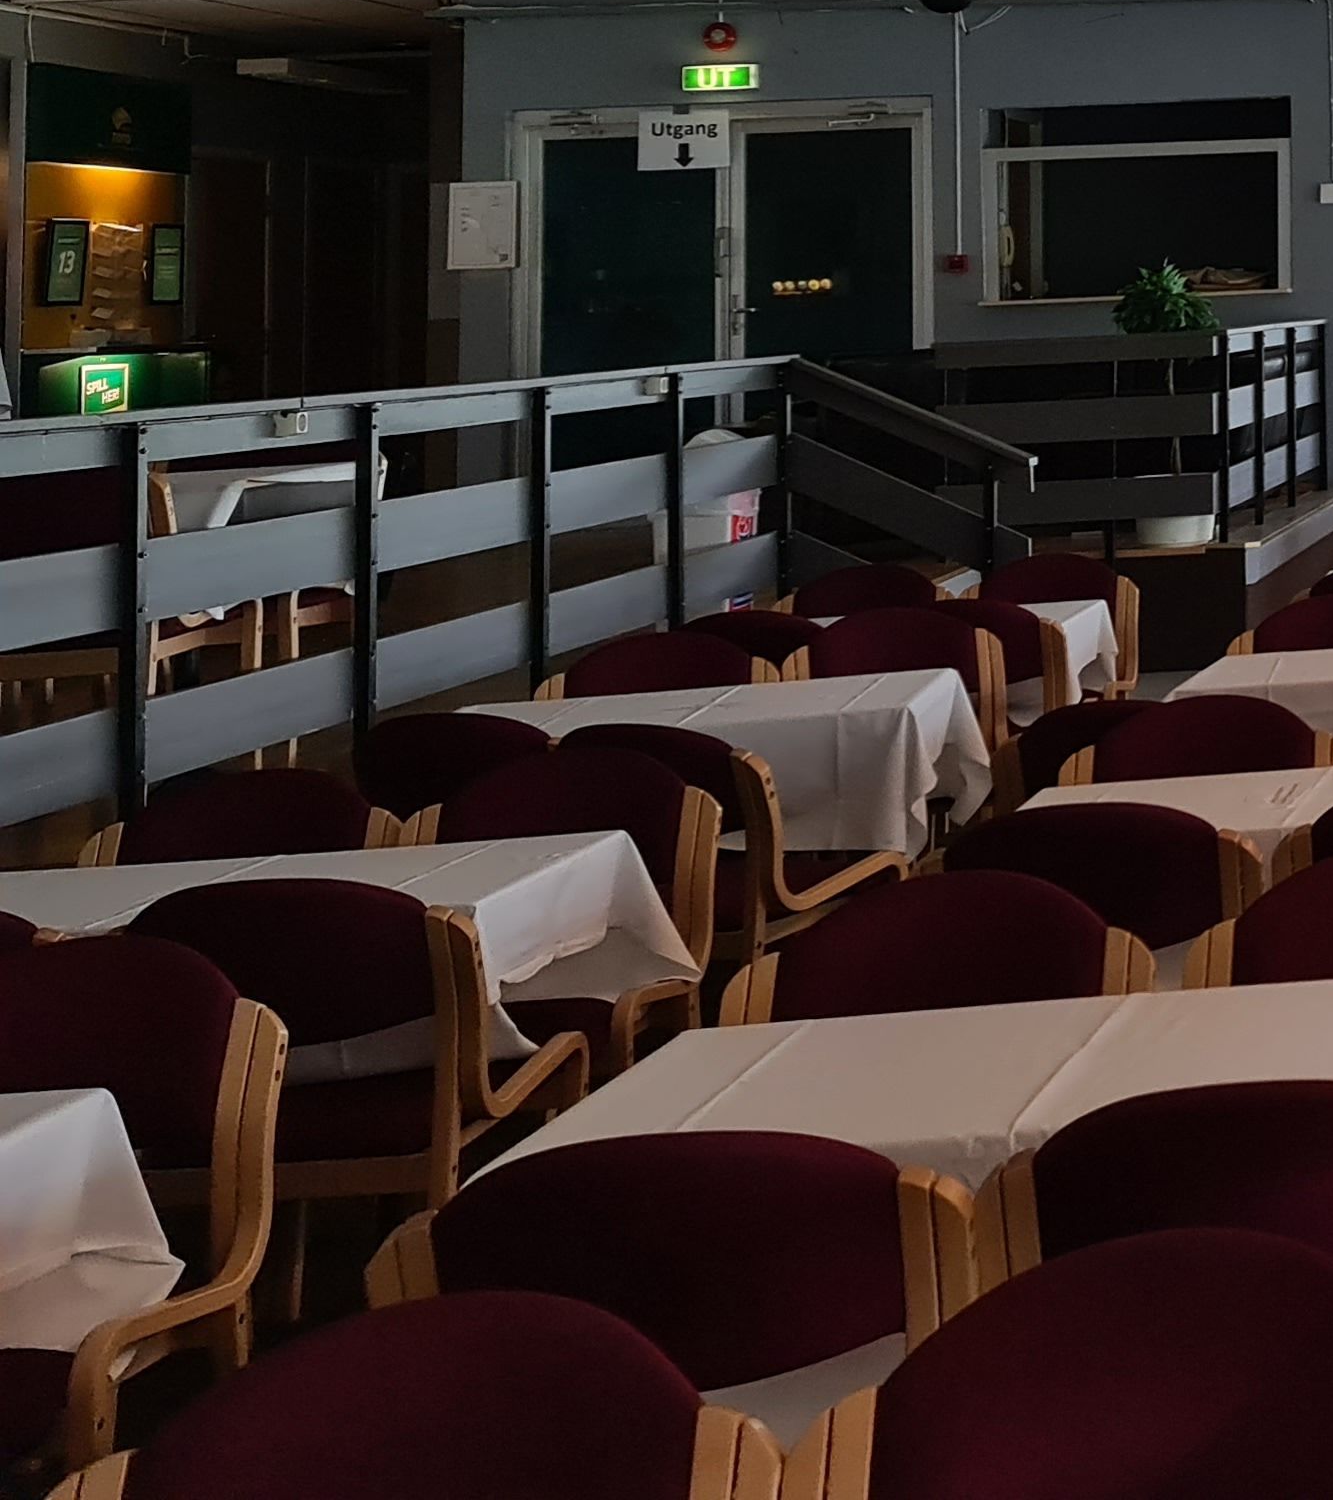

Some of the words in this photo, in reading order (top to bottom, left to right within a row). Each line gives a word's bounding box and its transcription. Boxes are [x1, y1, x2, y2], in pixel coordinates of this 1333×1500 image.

[697, 67, 735, 89] UT
[651, 122, 718, 140] Utgang
[58, 250, 76, 274] 13
[85, 377, 109, 396] SPILL
